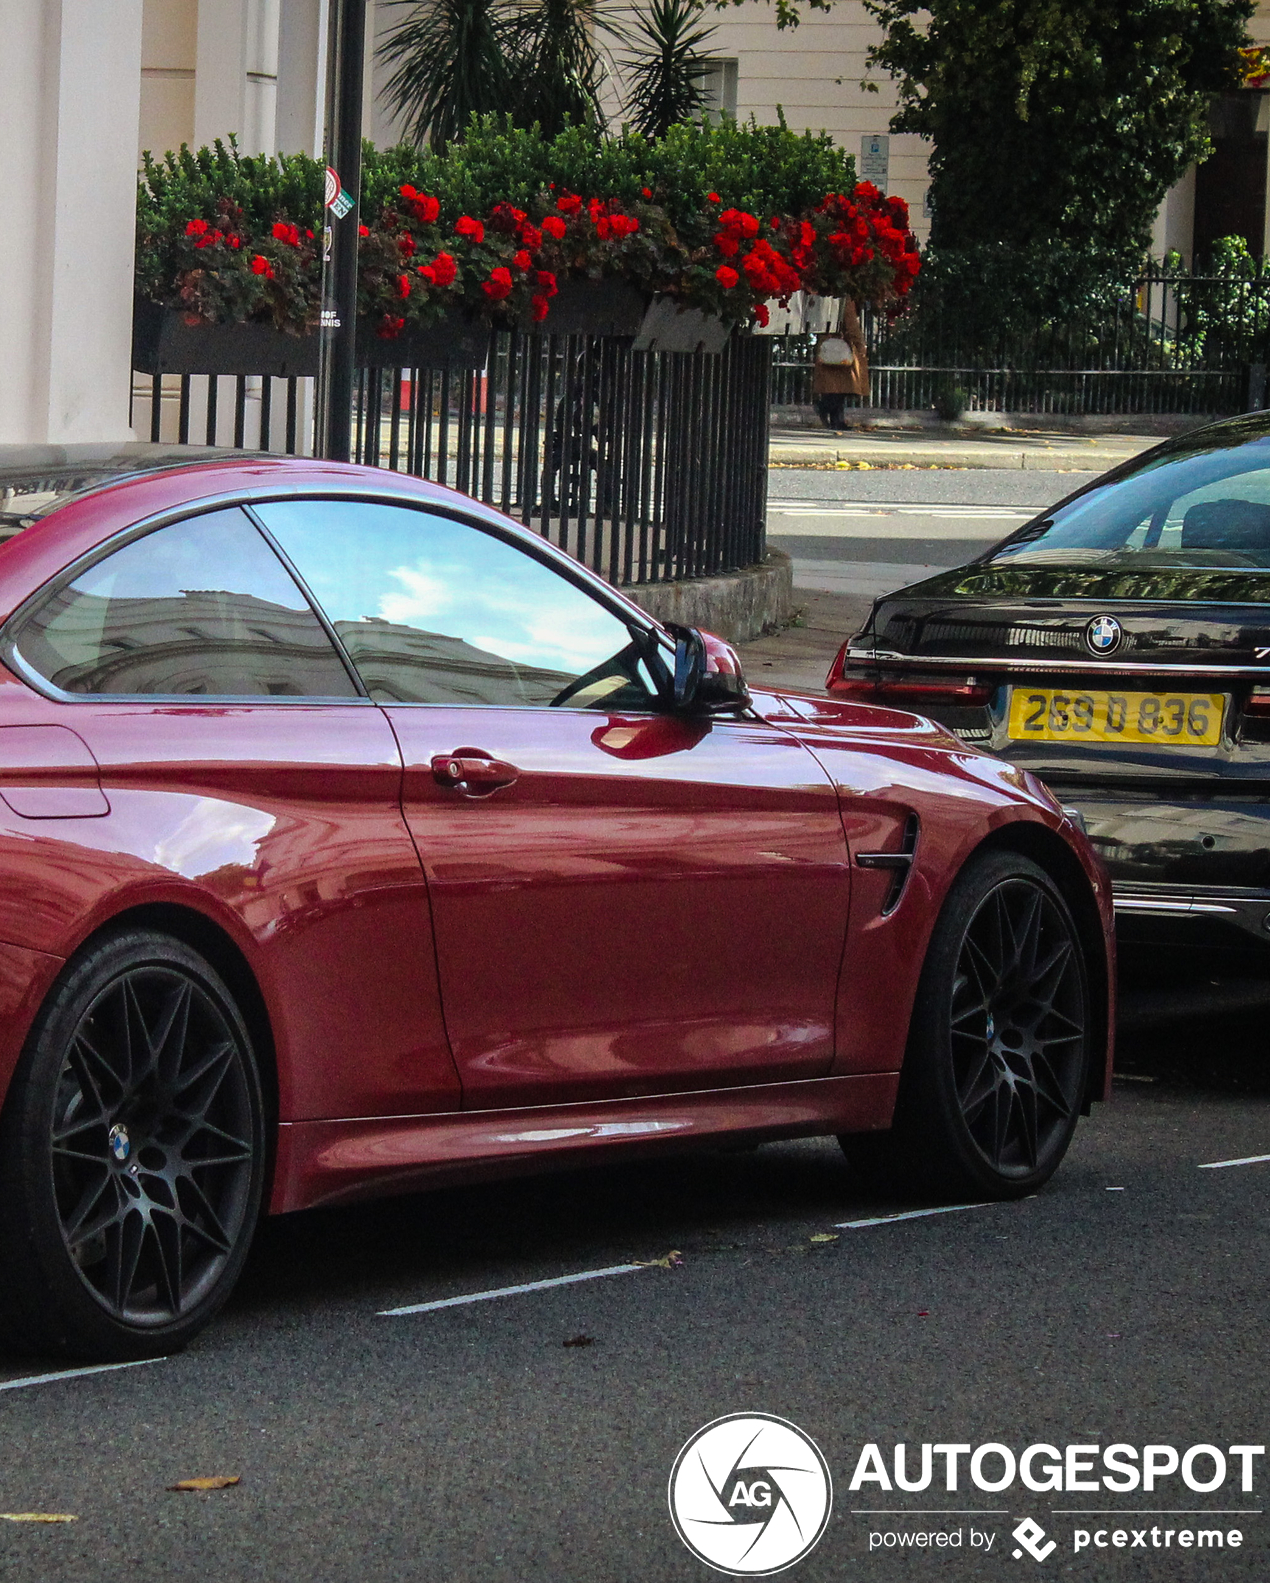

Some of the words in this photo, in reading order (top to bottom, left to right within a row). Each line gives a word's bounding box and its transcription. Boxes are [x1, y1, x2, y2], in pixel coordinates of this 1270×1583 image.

[1090, 618, 1118, 631] BMW
[1023, 694, 1094, 733] 269
[1104, 696, 1128, 734] D
[1138, 698, 1210, 737] 836
